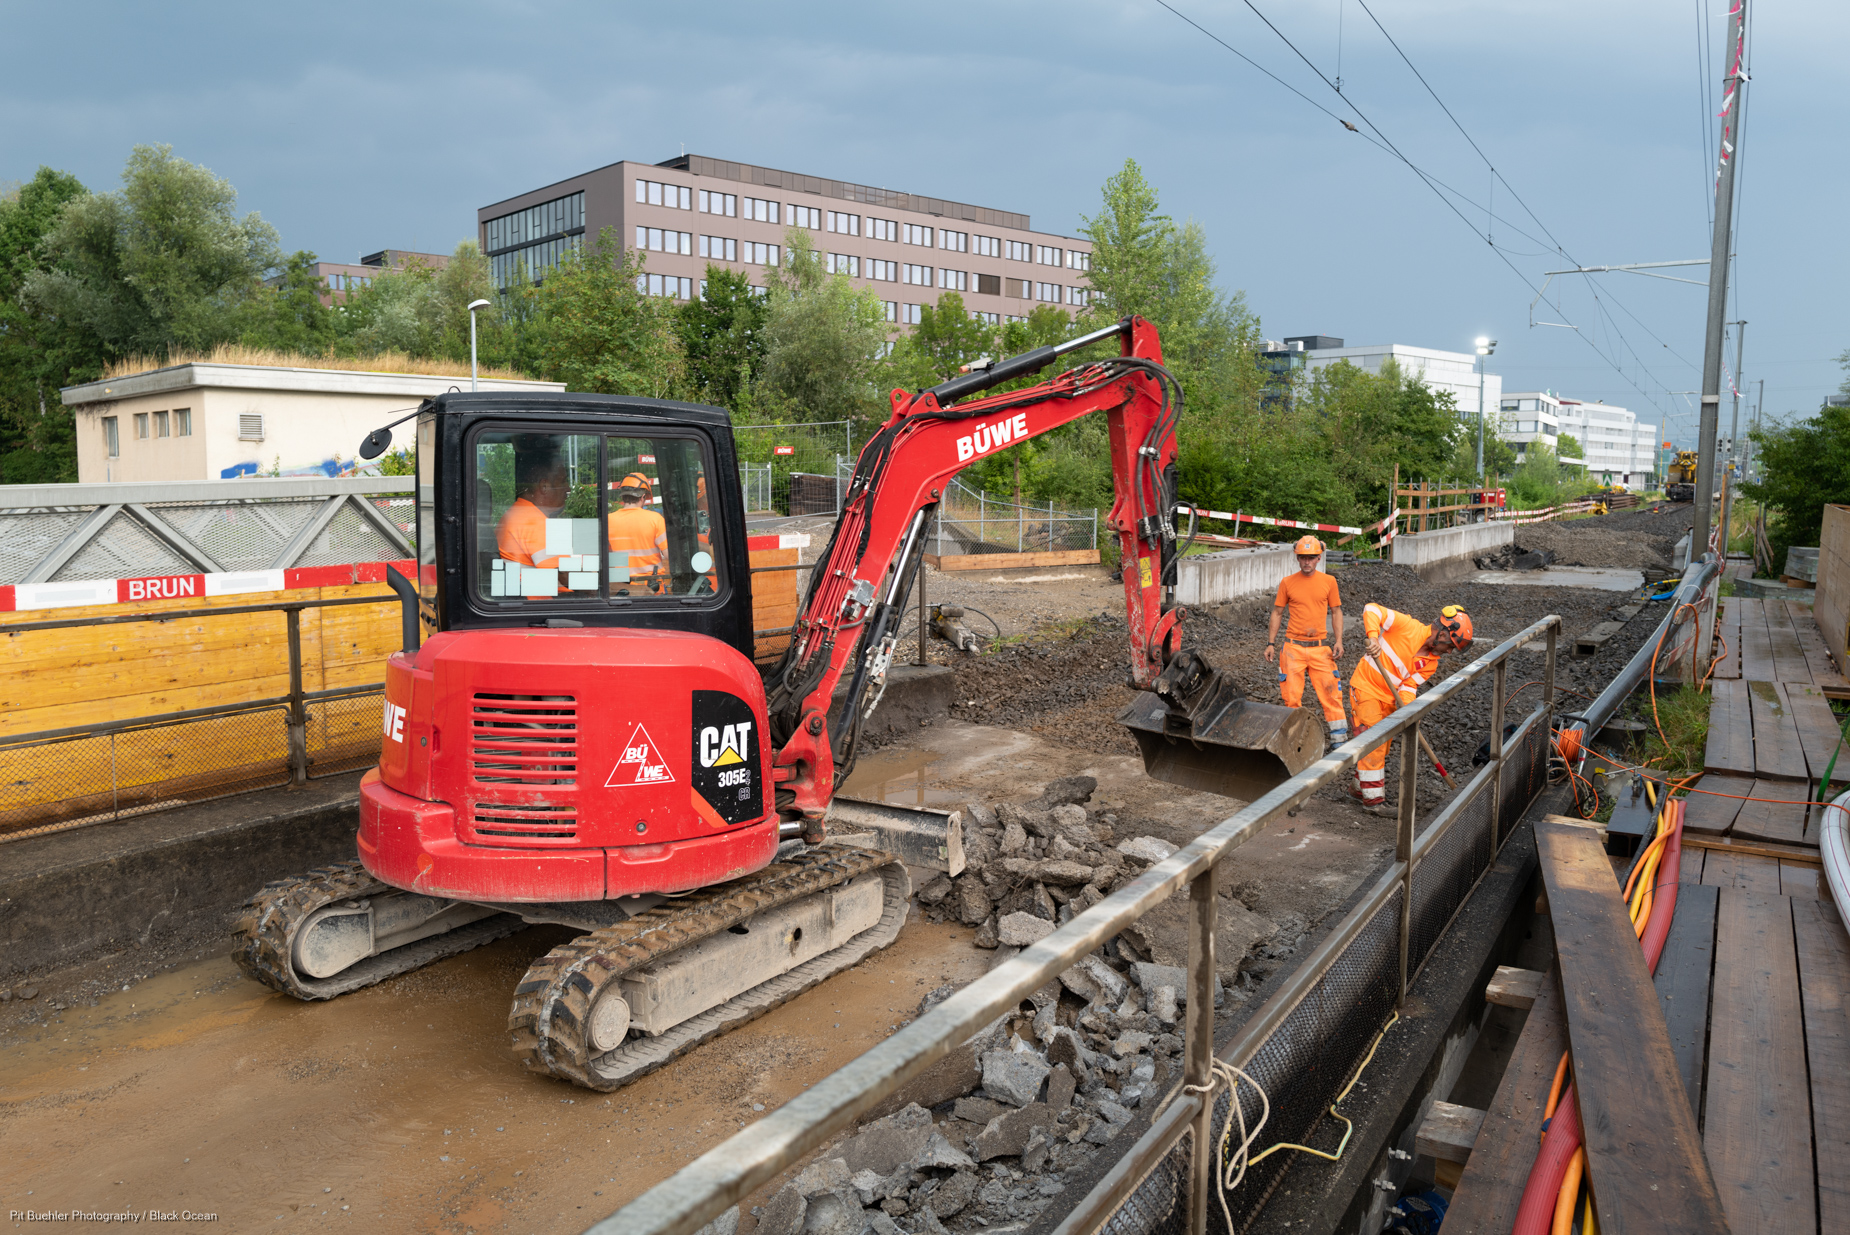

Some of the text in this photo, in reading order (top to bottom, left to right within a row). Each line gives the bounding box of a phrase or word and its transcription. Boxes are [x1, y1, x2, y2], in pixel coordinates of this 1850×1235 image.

[956, 412, 1029, 462] BÜWE
[128, 577, 195, 600] BRUN
[625, 743, 649, 760] BÜ
[700, 721, 752, 768] CAT
[643, 764, 665, 778] WE
[738, 786, 751, 802] CR
